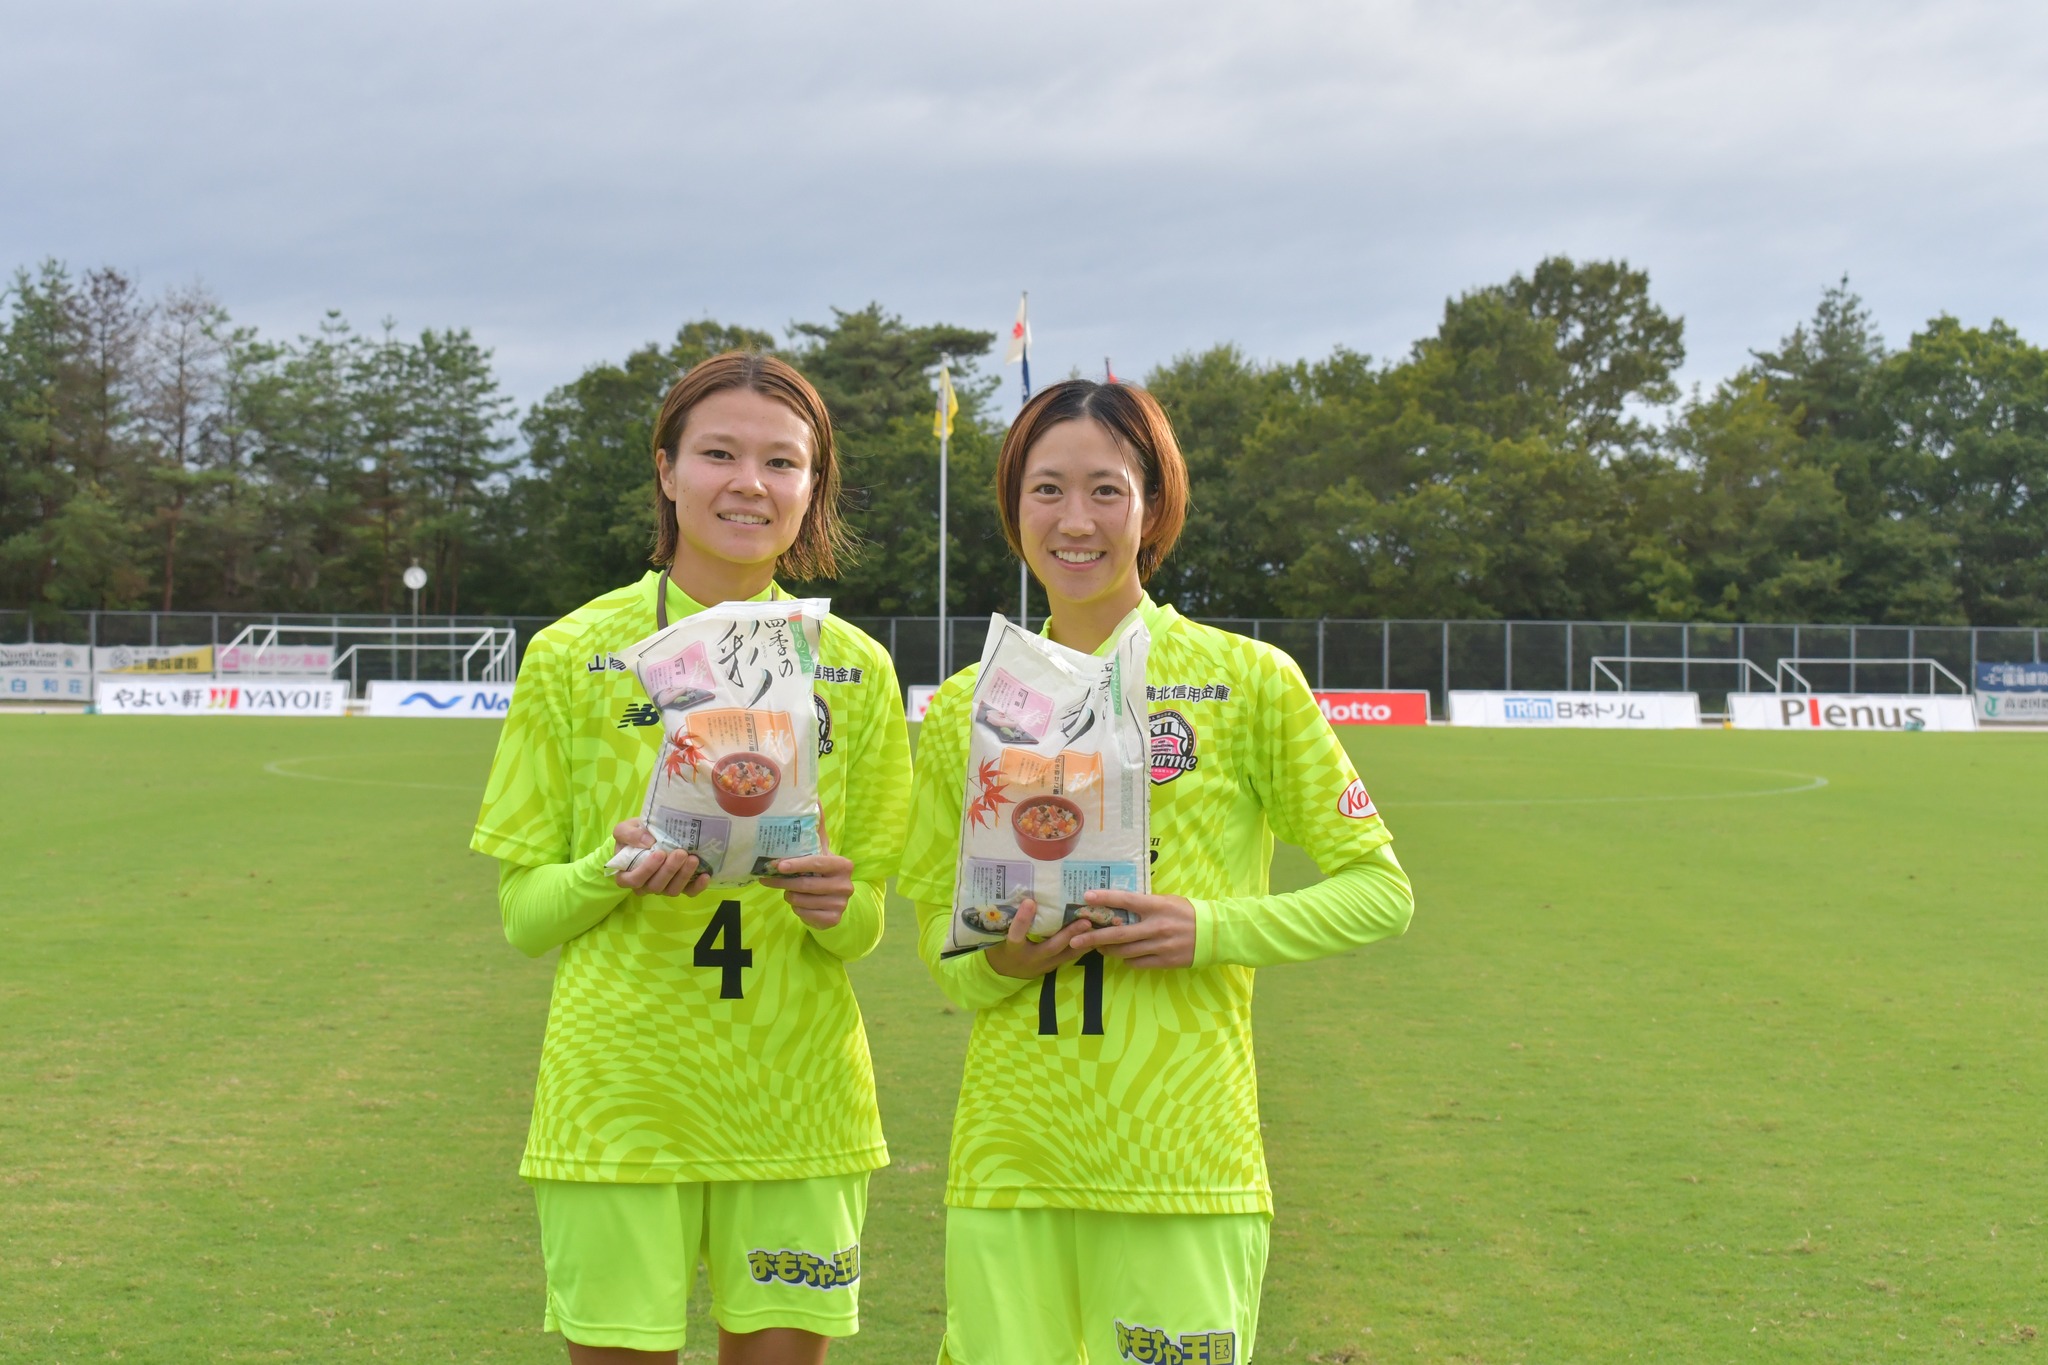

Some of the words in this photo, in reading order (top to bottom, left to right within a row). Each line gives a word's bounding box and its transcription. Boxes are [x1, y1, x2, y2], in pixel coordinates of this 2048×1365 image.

[764, 618, 794, 678] 四季の
[113, 688, 203, 708] やよい軒
[244, 689, 321, 709] YAYOI
[1557, 702, 1645, 720] 日本トリム
[1780, 698, 1926, 728] Plenus
[1150, 754, 1196, 770] arme
[693, 900, 753, 999] 4
[1038, 951, 1104, 1035] 11
[1115, 1321, 1236, 1365] おもちゃ王国
